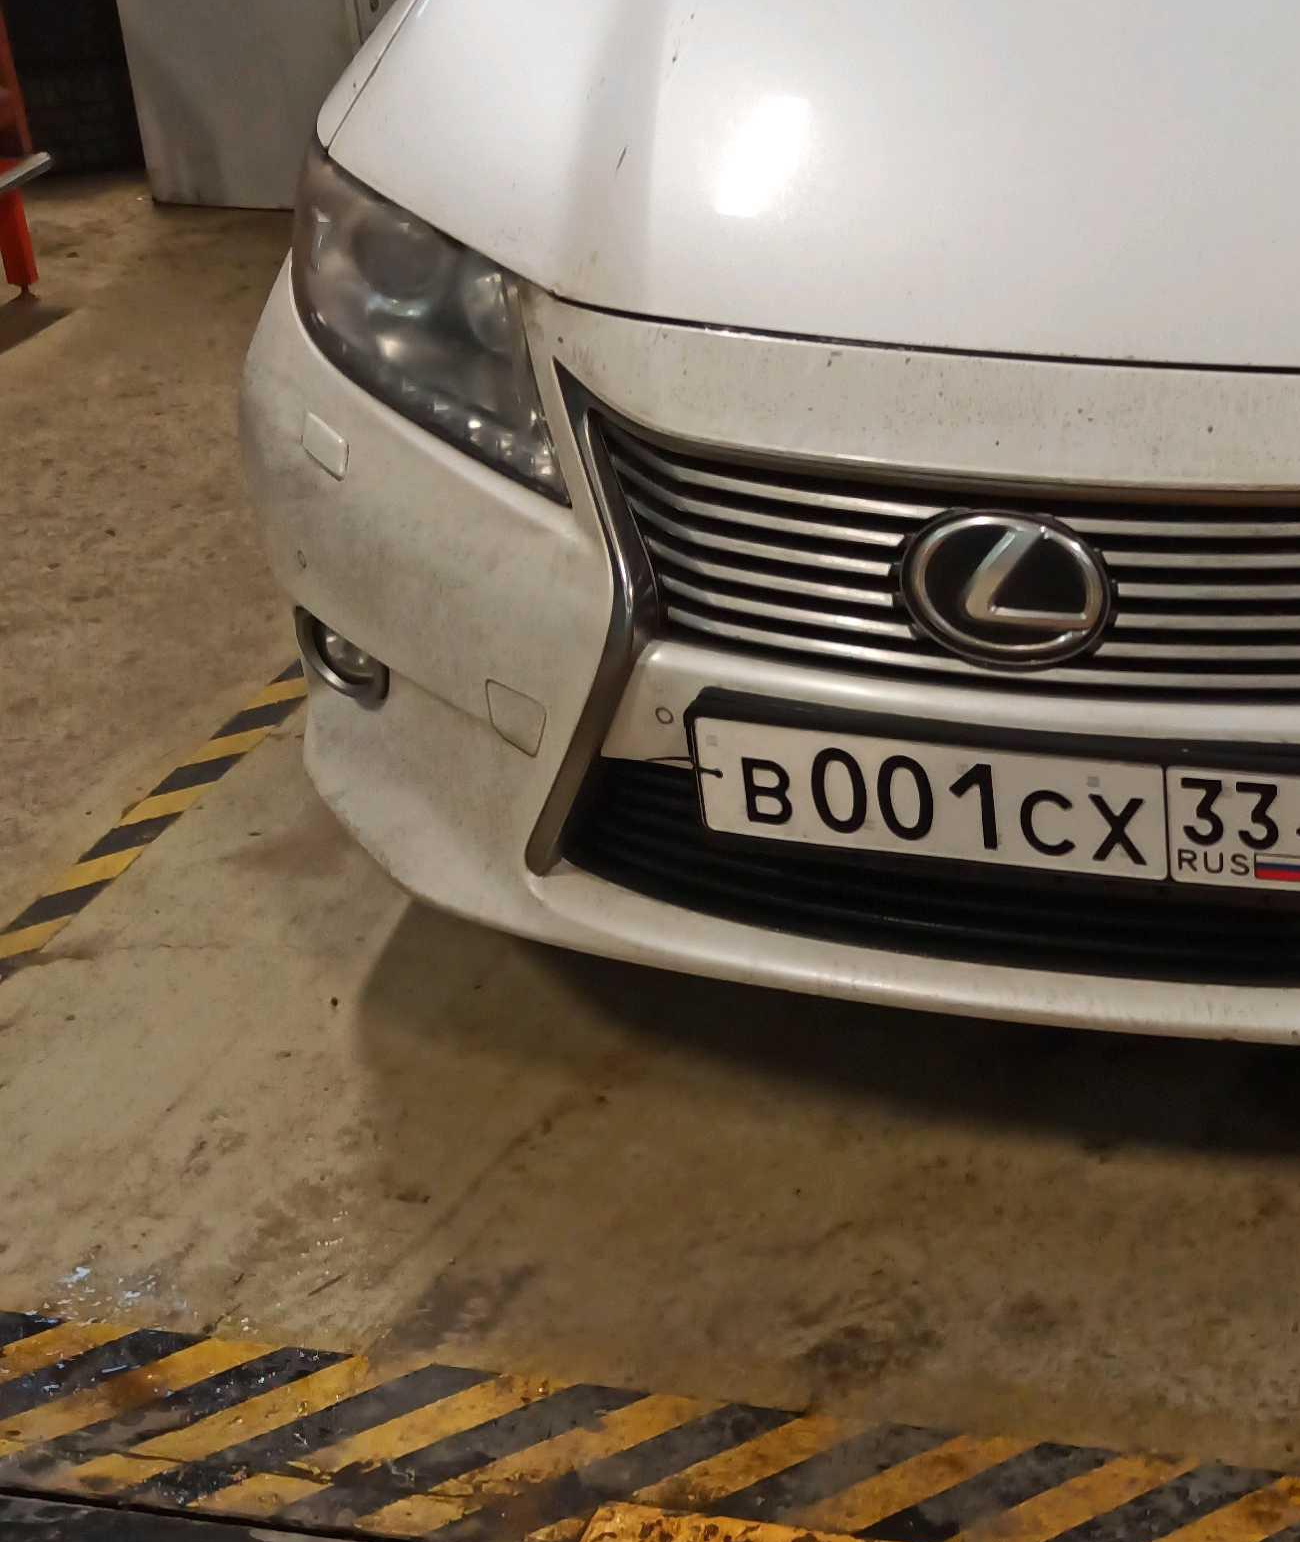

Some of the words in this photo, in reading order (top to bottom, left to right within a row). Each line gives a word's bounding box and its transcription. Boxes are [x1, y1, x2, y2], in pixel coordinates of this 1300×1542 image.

[741, 747, 1147, 866] В001СХ
[1181, 777, 1280, 850] 33
[1177, 847, 1250, 876] RUS
